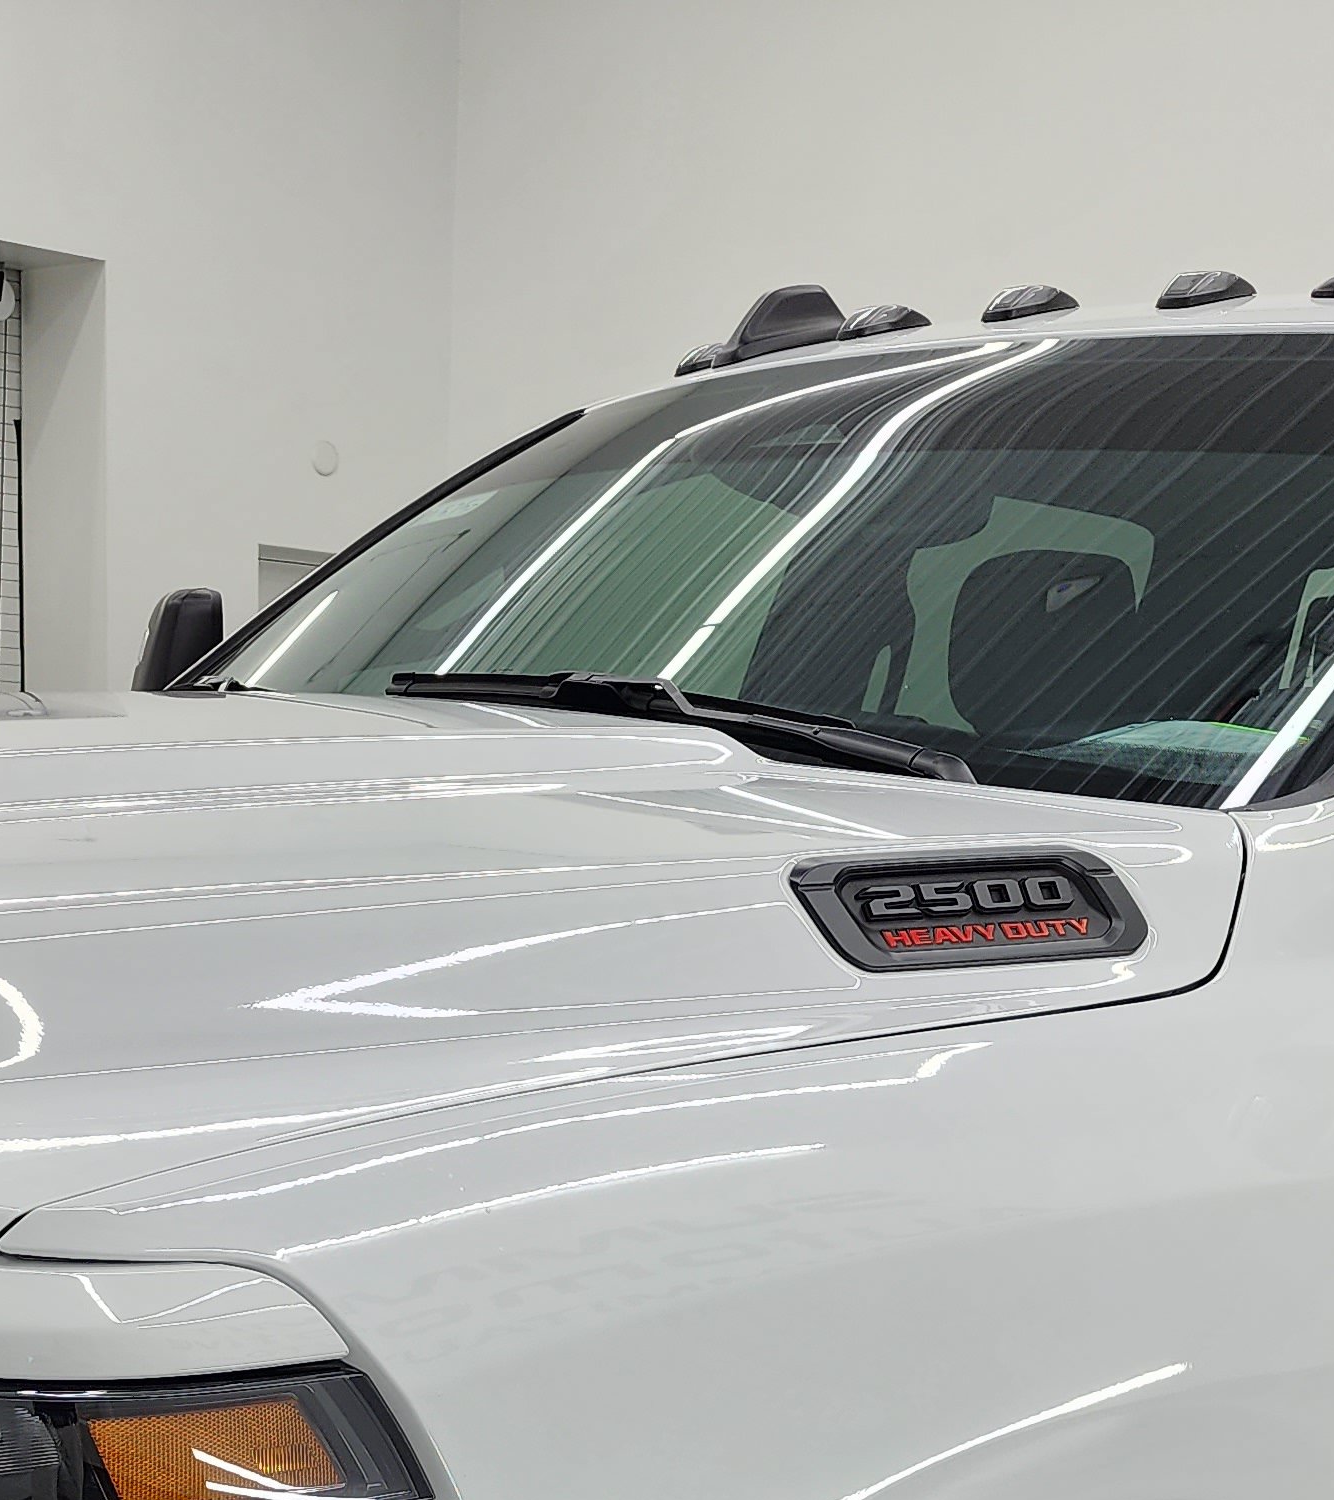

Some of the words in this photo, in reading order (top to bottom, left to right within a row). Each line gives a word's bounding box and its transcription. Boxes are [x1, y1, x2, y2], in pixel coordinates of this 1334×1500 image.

[859, 875, 1075, 922] 2500
[880, 925, 996, 949] HEAVY
[1002, 917, 1090, 941] DUTY
